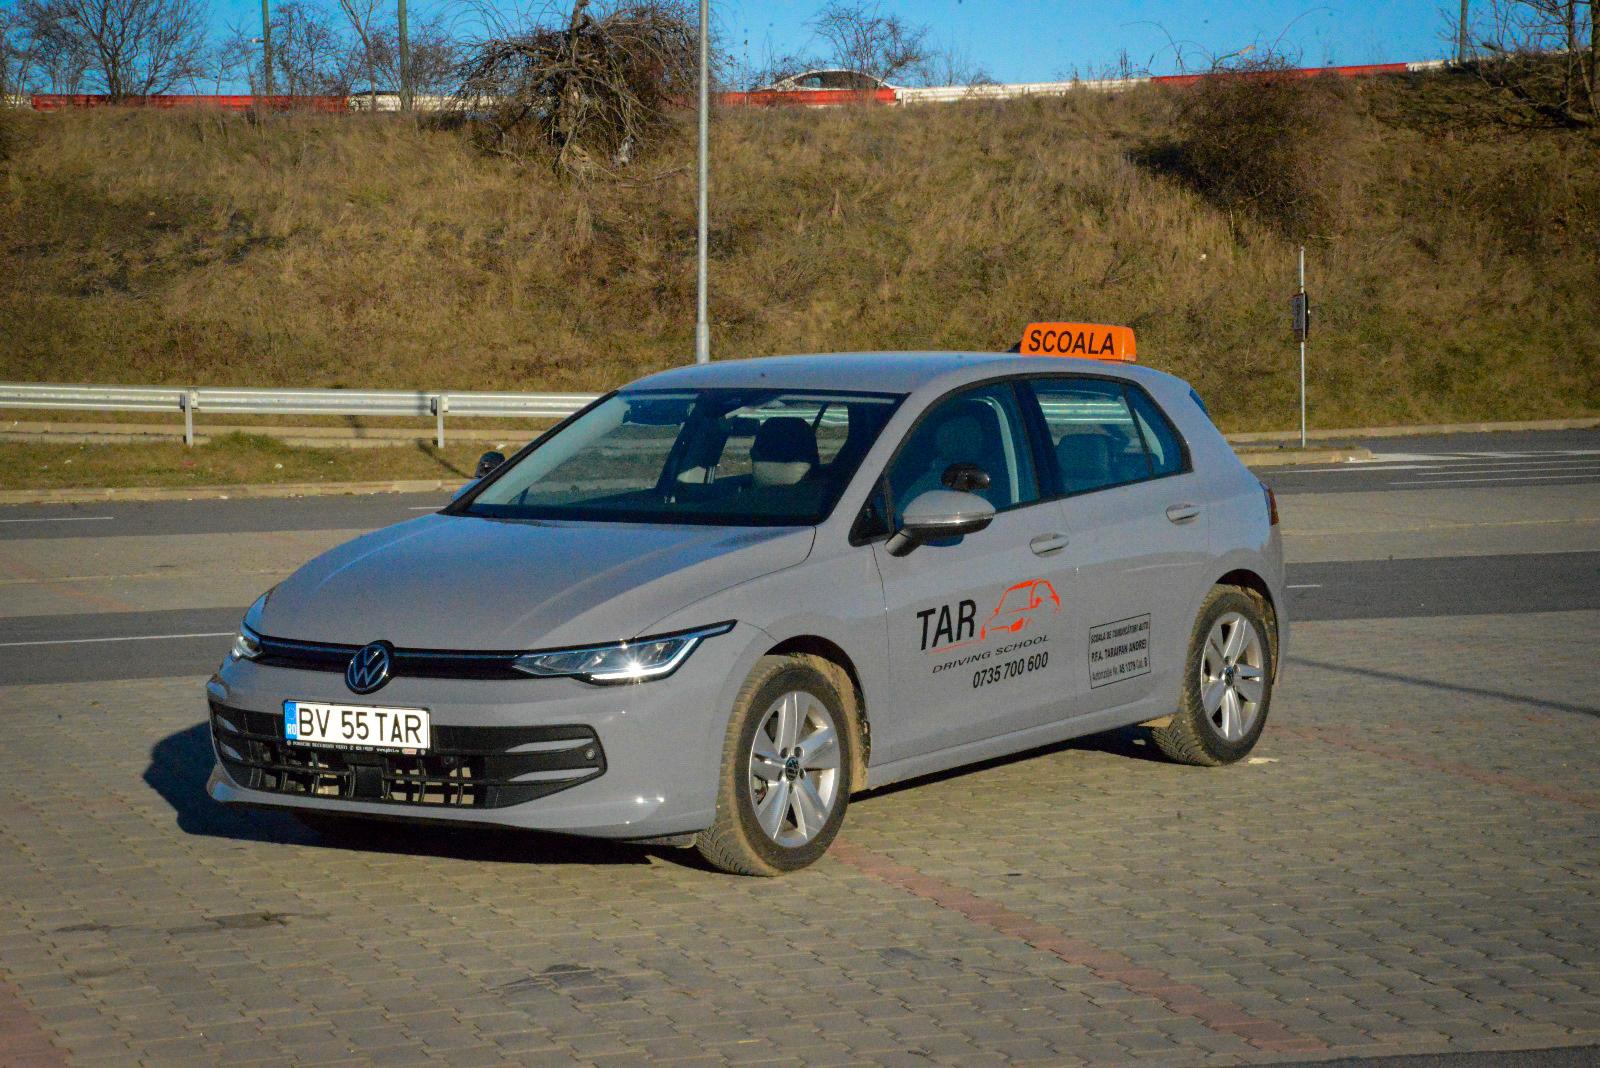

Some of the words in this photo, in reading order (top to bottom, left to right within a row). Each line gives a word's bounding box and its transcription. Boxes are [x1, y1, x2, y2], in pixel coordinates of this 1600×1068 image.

[1028, 330, 1114, 355] SCOALA
[917, 599, 976, 650] TAR
[932, 651, 991, 674] DRIVING
[995, 635, 1049, 655] SCHOOL
[973, 665, 1001, 689] 0735
[1003, 658, 1025, 680] 700
[1027, 651, 1049, 672] 600
[299, 708, 331, 737] BV
[341, 710, 369, 740] 55
[375, 712, 422, 743] TAR
